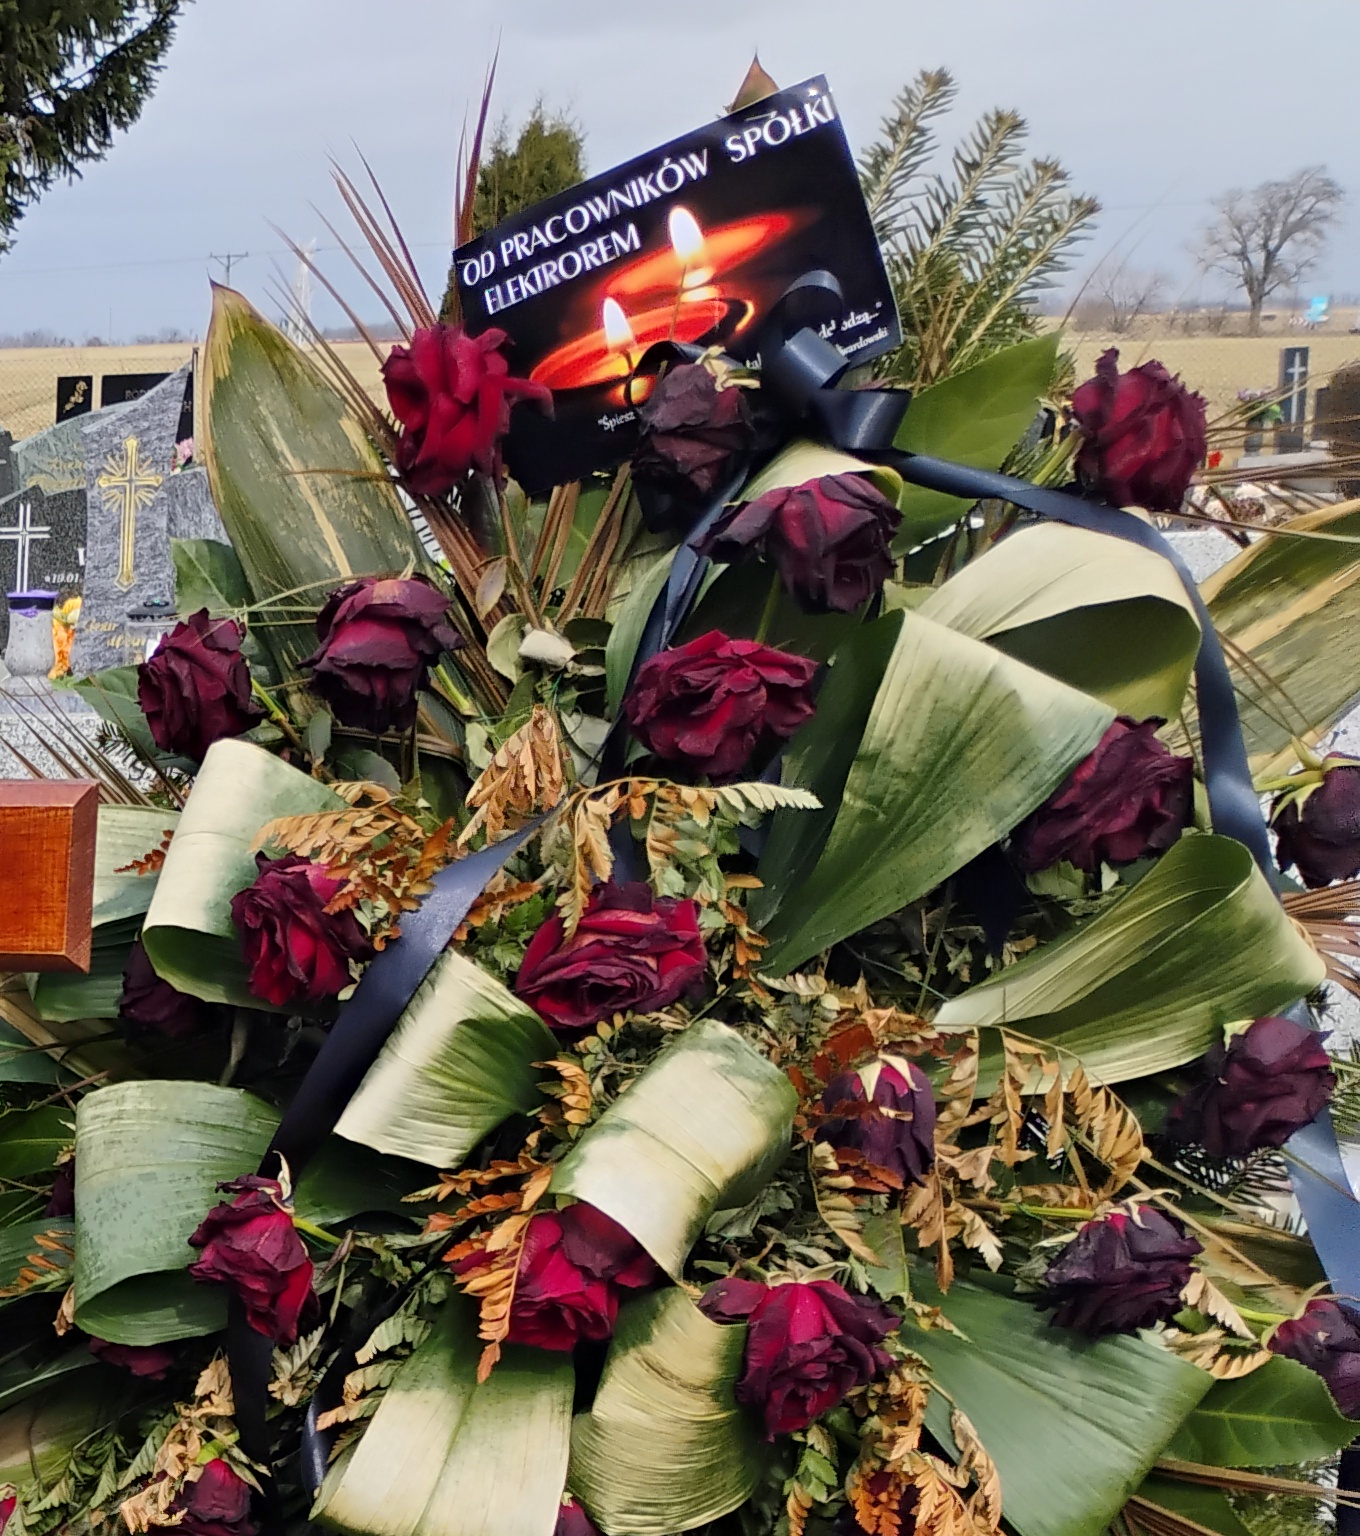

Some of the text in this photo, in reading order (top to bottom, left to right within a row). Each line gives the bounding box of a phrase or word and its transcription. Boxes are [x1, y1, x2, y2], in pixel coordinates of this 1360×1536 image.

[463, 95, 836, 287] OD PRACOWNIKÓW SPÓŁKI
[484, 223, 641, 316] ELEKTROREM
